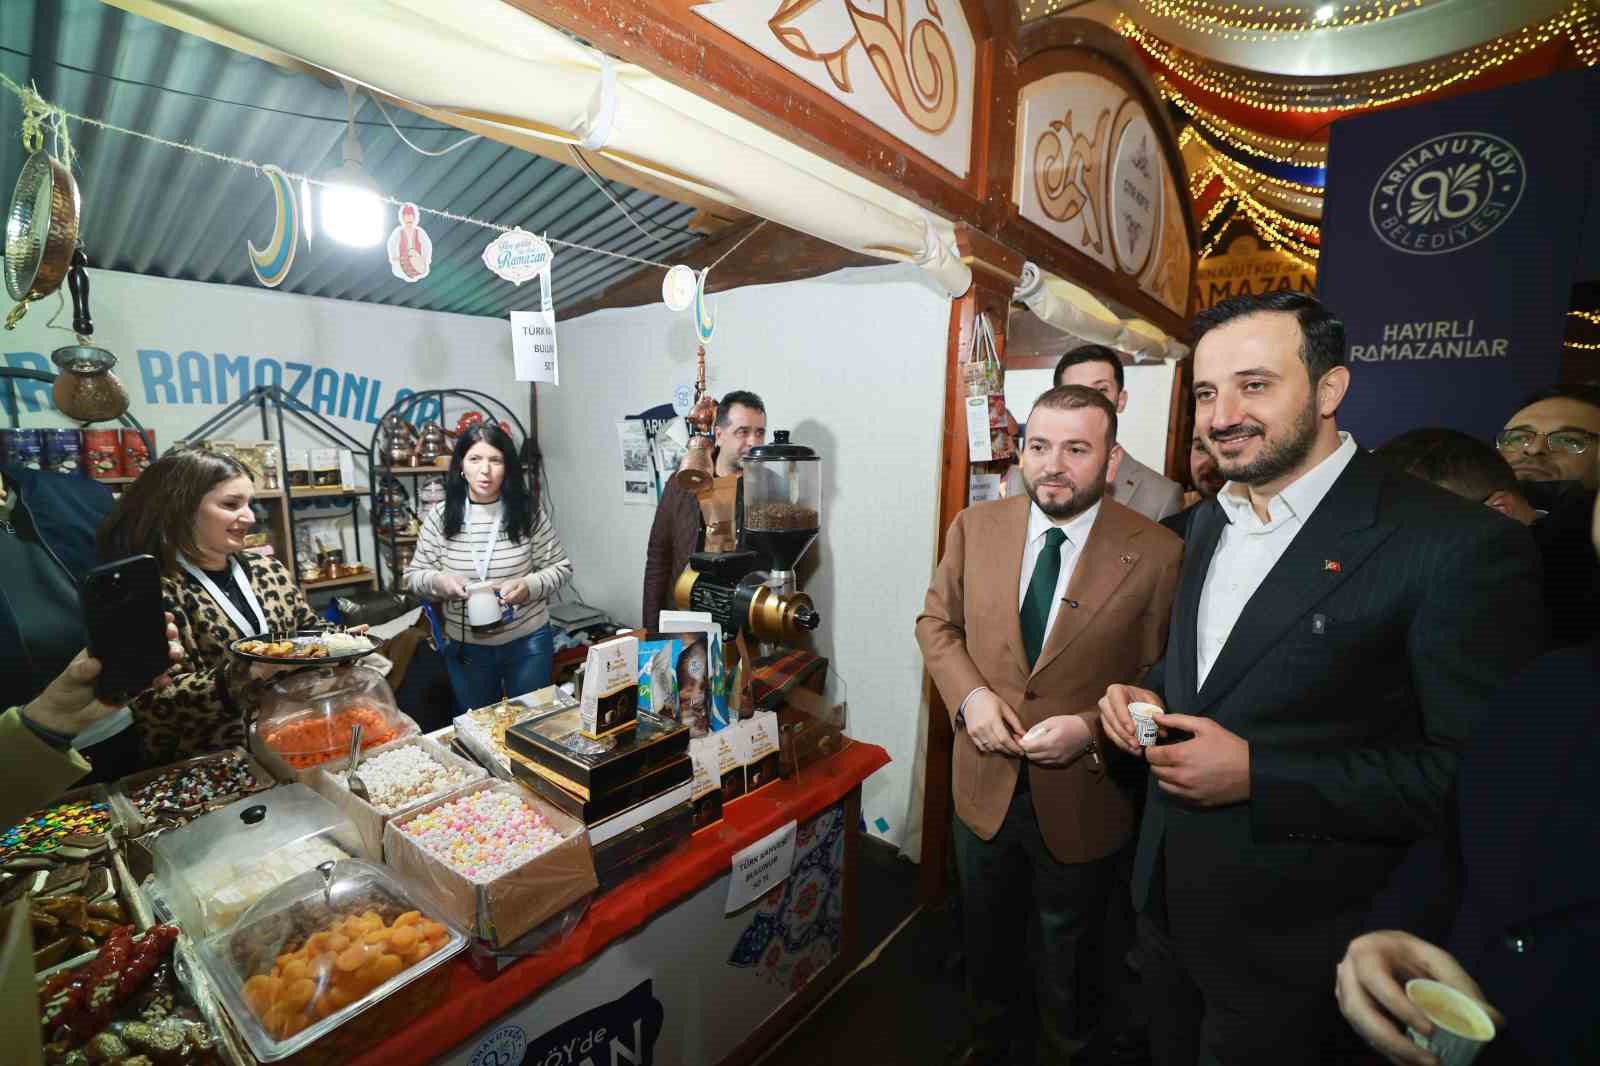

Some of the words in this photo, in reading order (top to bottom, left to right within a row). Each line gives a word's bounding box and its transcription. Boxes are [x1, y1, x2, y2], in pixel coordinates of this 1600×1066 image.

[1382, 138, 1518, 197] ARNAVUTKÖY
[496, 250, 545, 268] Ramazan
[1383, 319, 1474, 342] HAYIRLI
[1350, 338, 1509, 362] RAMAZANLAR
